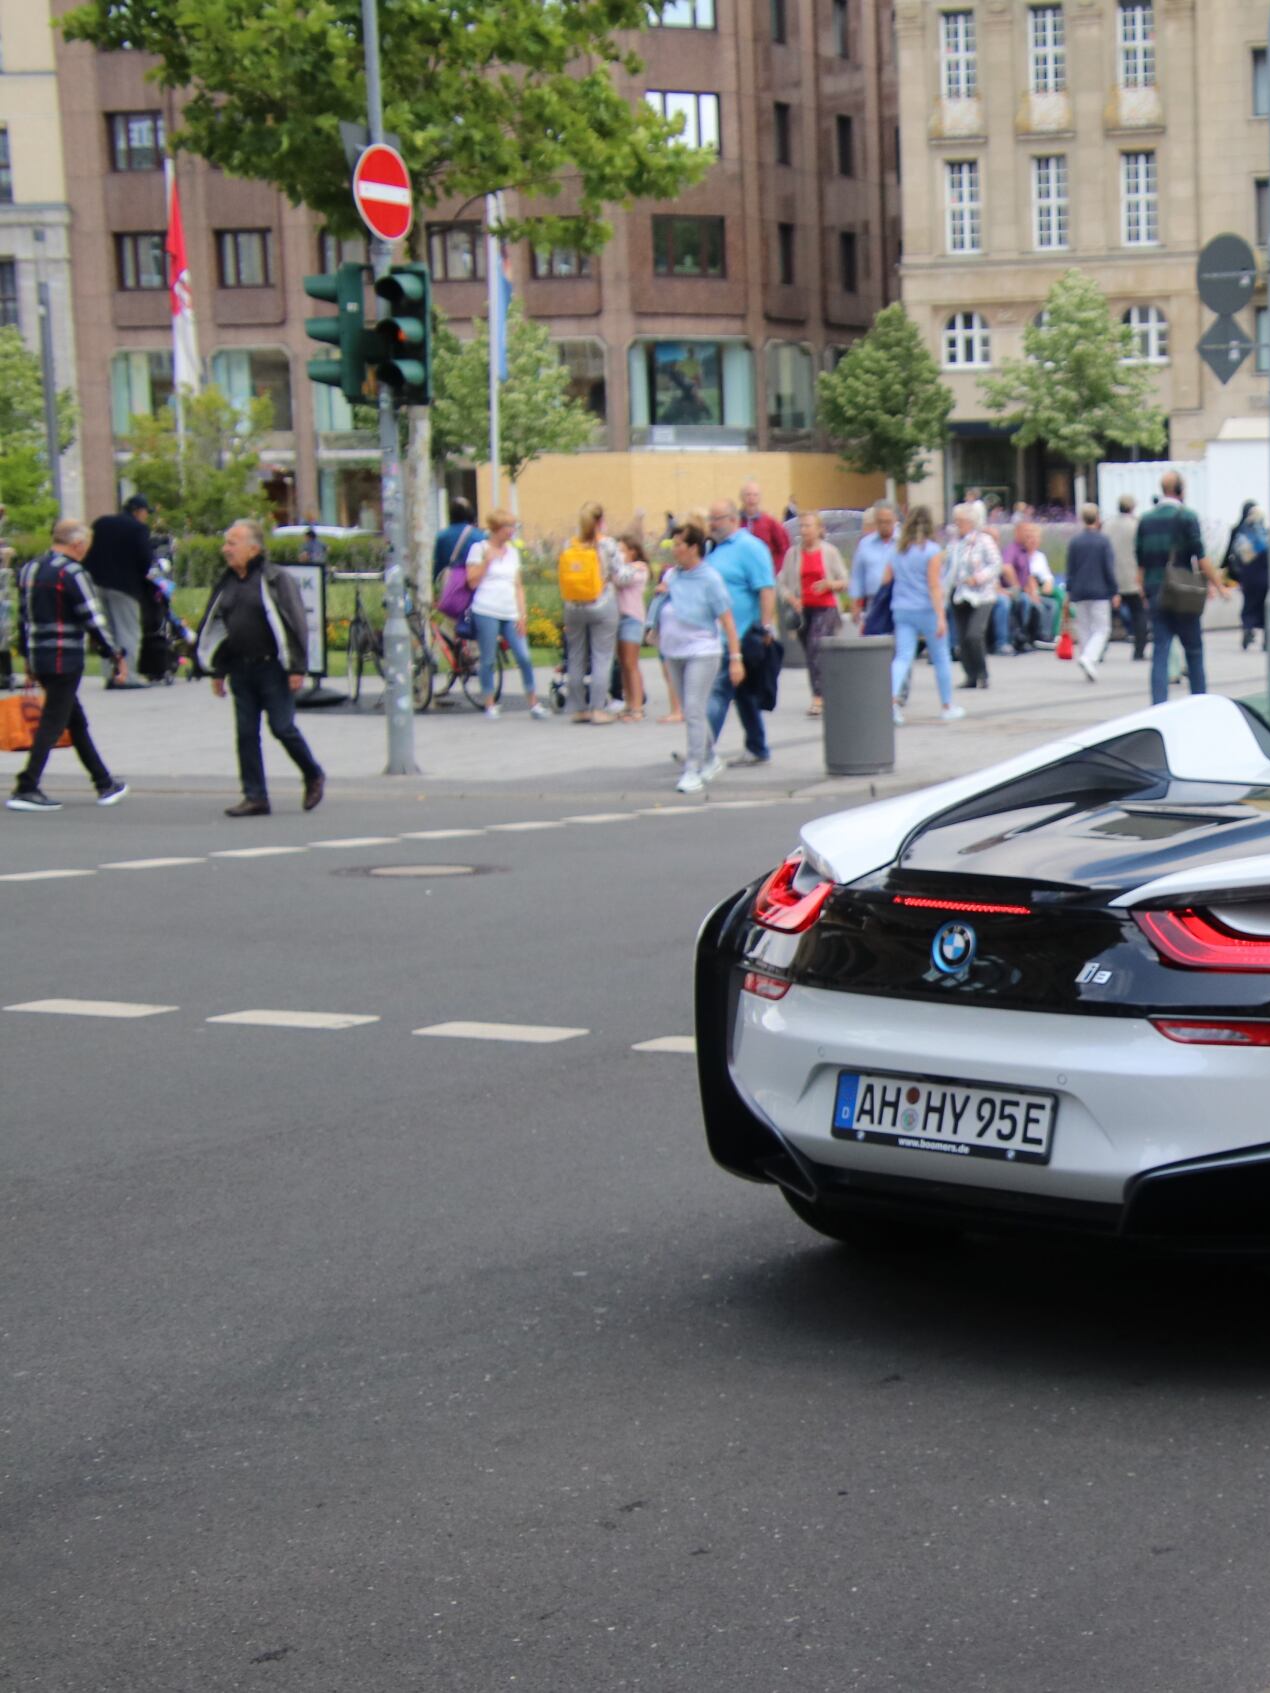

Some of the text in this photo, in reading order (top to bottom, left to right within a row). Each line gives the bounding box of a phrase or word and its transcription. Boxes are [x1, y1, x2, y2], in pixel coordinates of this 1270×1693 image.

[841, 1106, 850, 1120] D
[856, 1083, 1046, 1146] AH HY 95E
